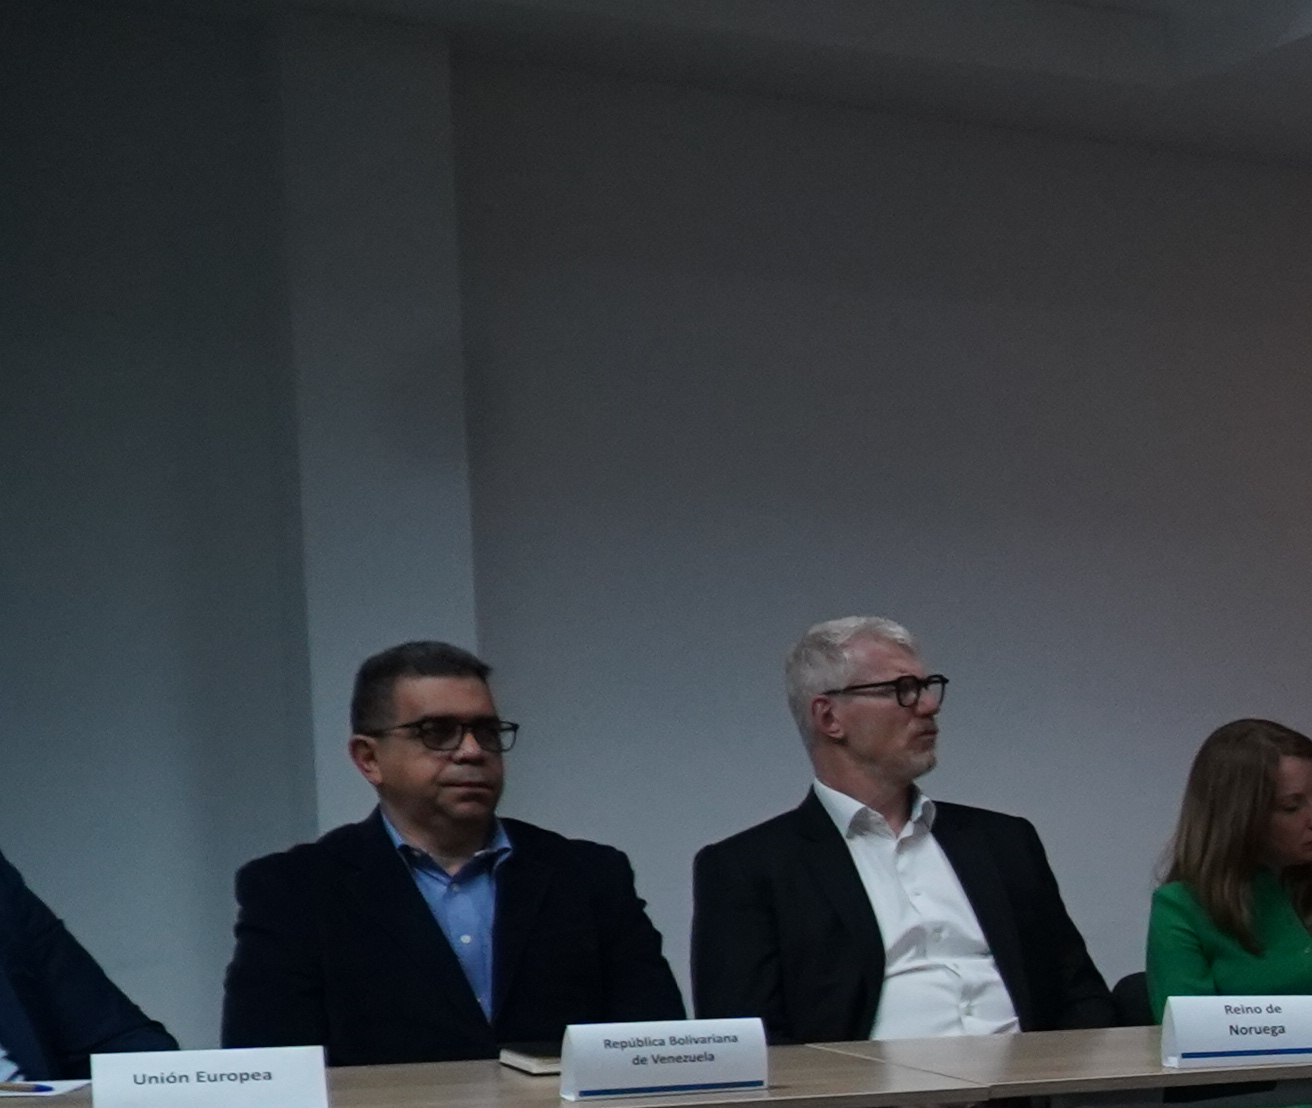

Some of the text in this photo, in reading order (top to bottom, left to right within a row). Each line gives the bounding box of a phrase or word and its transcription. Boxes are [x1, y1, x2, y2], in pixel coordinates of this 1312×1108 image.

[1224, 1003, 1282, 1015] Reino de
[1228, 1023, 1286, 1037] Noruega
[603, 1033, 739, 1050] República Bolivariana
[632, 1051, 715, 1066] de Venezuela
[132, 1070, 273, 1086] Unión Europea
